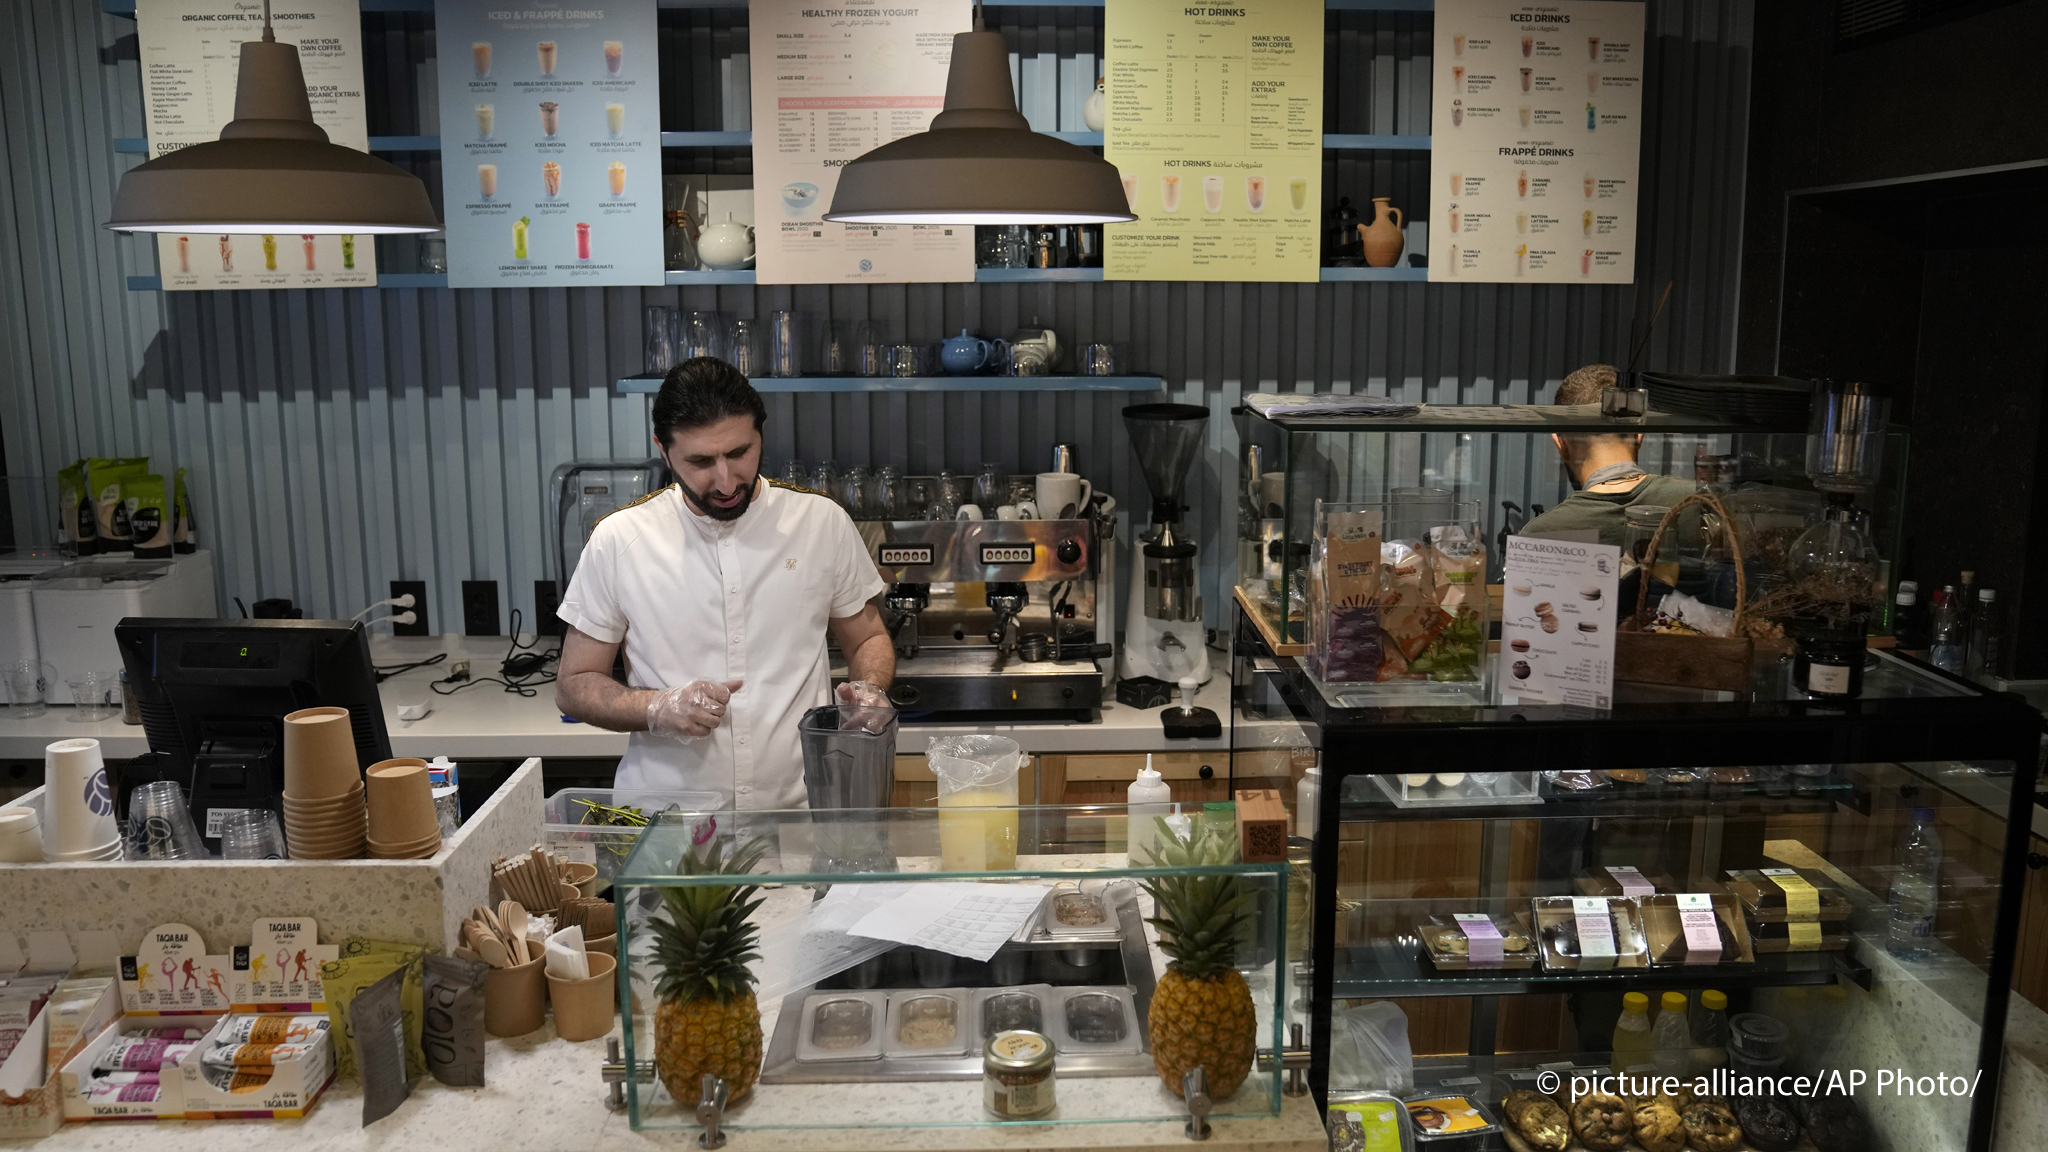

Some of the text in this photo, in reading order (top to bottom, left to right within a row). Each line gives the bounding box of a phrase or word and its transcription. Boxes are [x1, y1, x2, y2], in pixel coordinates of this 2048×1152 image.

[234, 2, 261, 12] Organic
[488, 9, 604, 20] ICED & FRAPPÉ DRINKS
[802, 10, 843, 18] HEALTHY
[845, 9, 880, 17] FROZEN
[1184, 8, 1245, 17] HOT DRINKS
[1510, 14, 1570, 23] ICED DRINKS
[1499, 146, 1574, 157] FRAPPÉ DRINKS
[269, 923, 302, 932] TAQA BAR
[156, 934, 189, 942] TAQA BAR
[264, 1100, 281, 1108] TAQA
